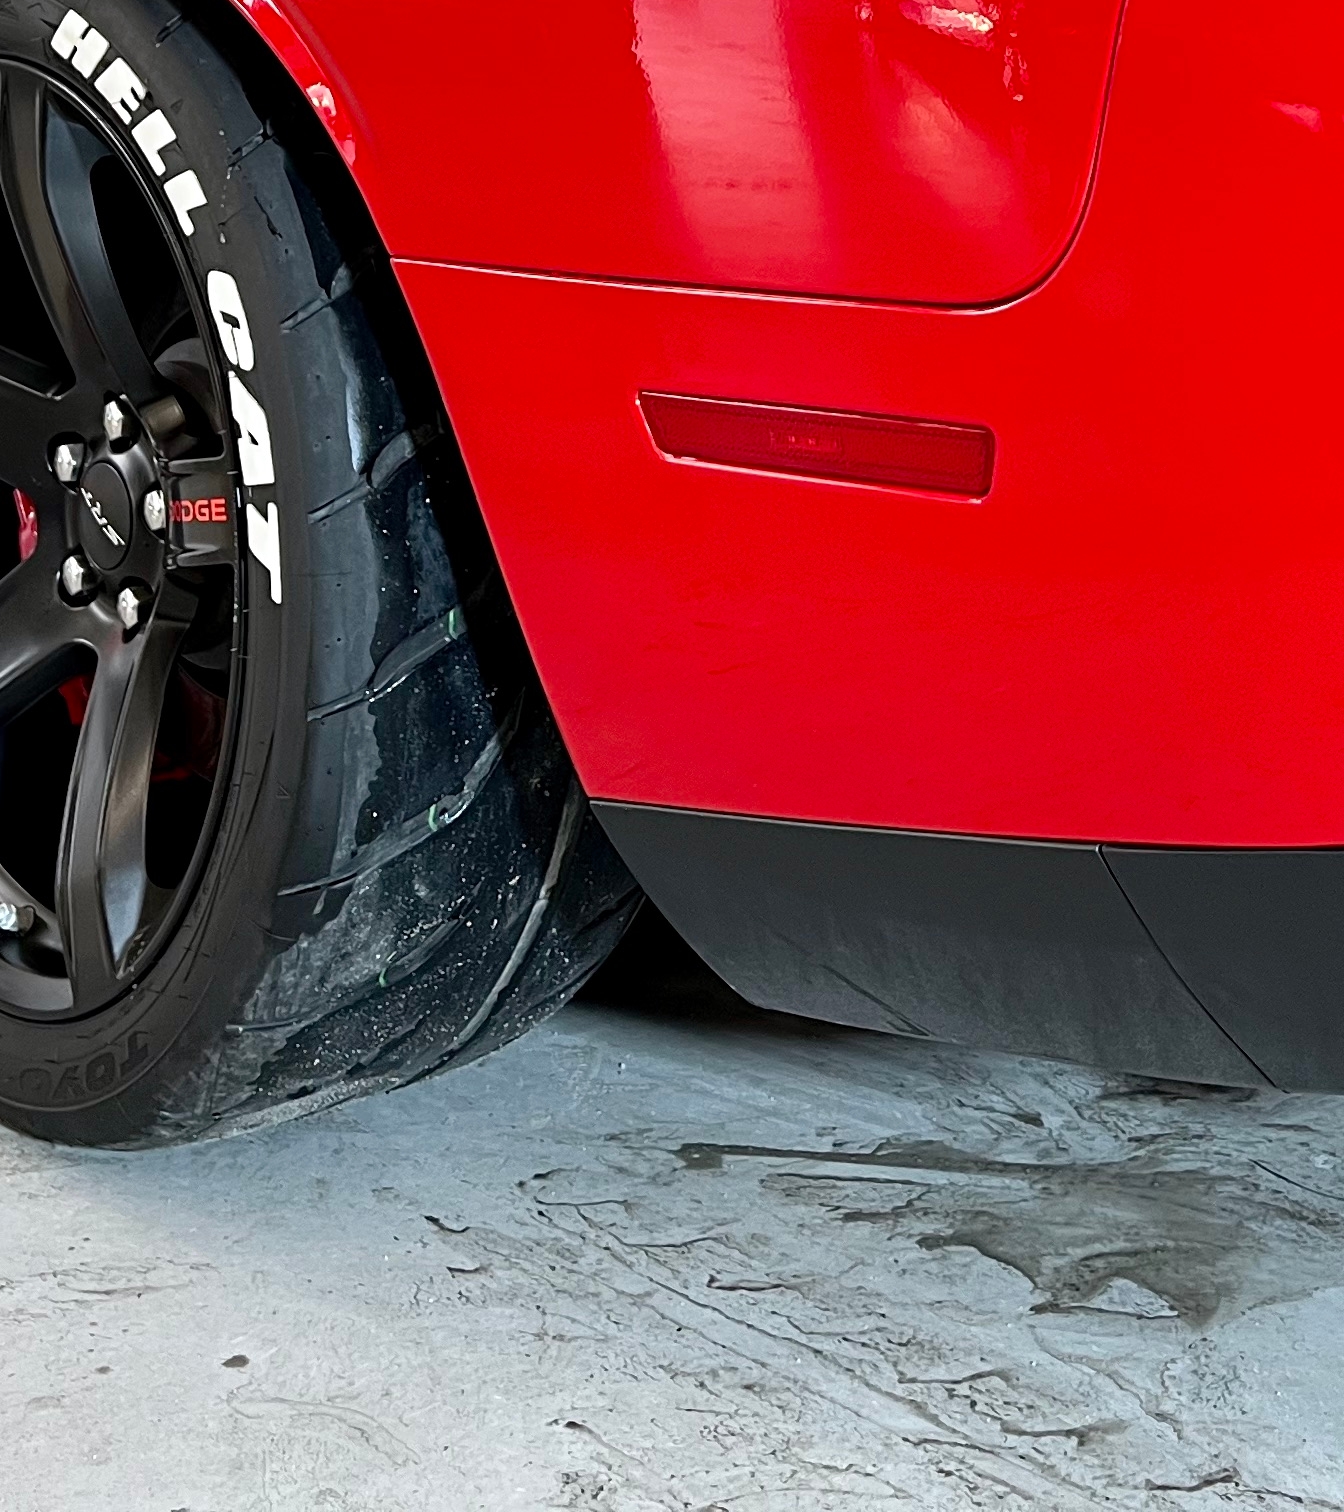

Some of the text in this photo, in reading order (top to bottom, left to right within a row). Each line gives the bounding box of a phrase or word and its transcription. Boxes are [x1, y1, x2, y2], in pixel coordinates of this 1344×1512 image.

[50, 9, 282, 604] HELL CAT
[81, 488, 126, 546] SRT
[18, 1030, 150, 1100] TOYO
